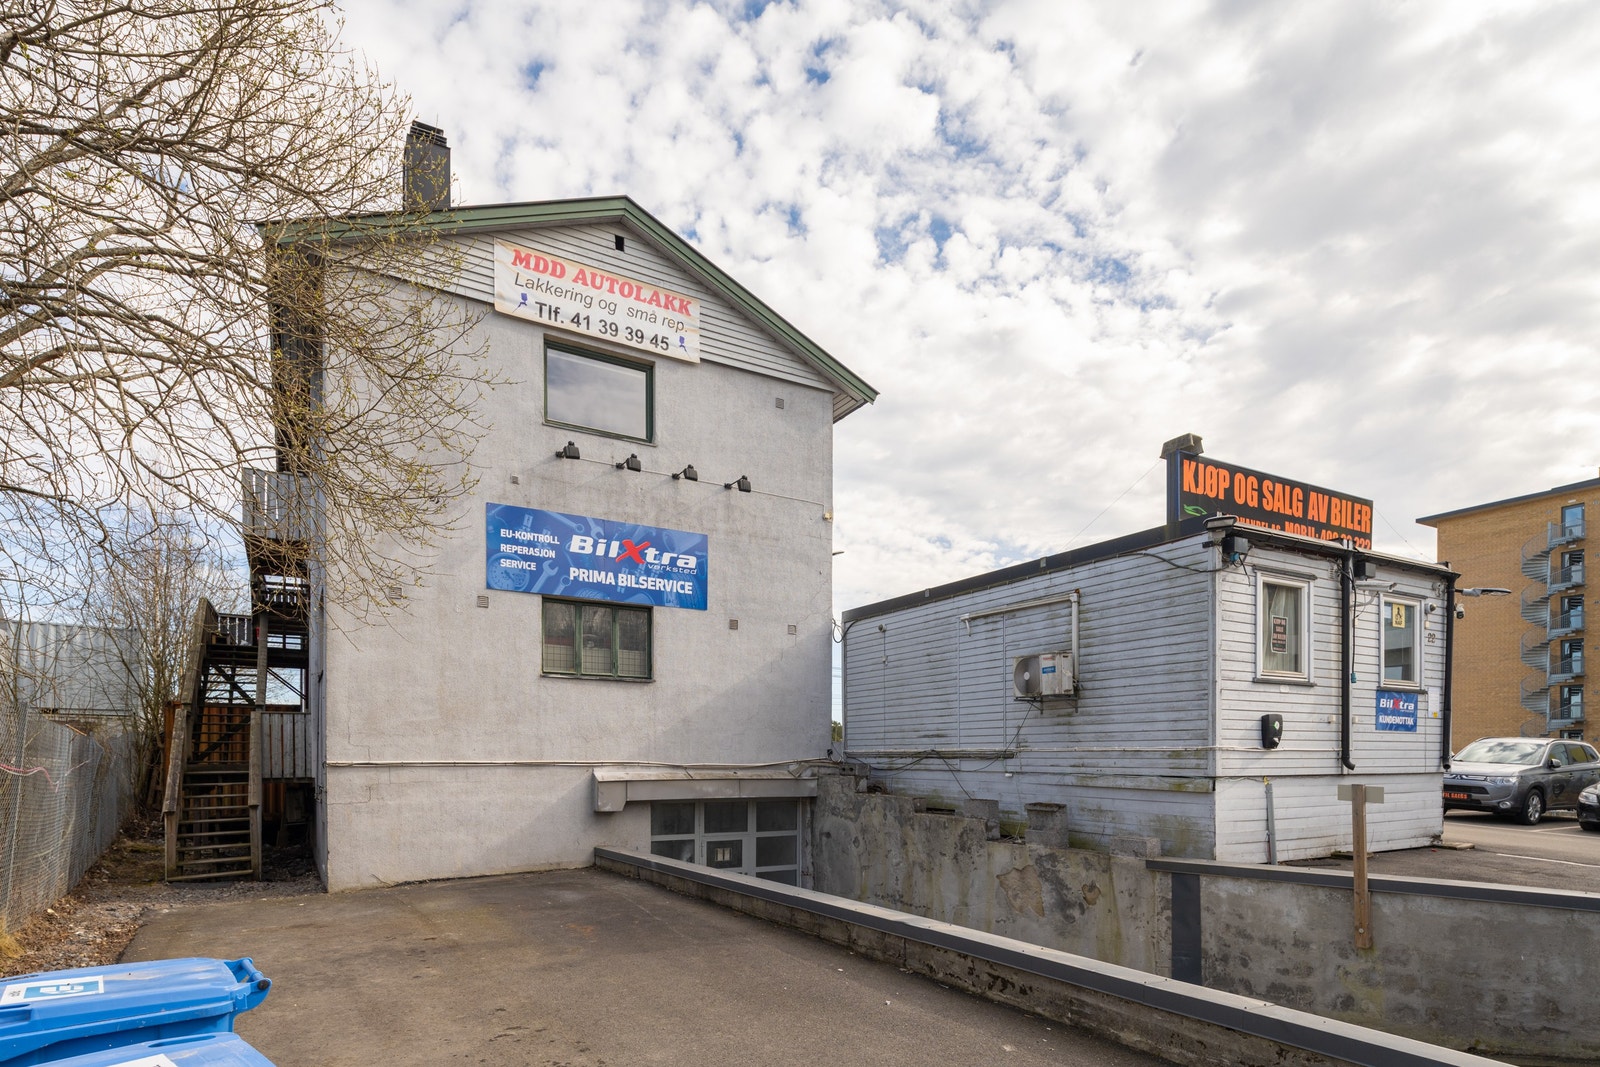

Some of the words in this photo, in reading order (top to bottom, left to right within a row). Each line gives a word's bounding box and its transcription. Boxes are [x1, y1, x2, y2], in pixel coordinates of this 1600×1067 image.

[511, 248, 566, 279] MDD
[572, 268, 692, 317] AUTOLAKK
[515, 272, 593, 309] Lakkering
[599, 299, 617, 315] og
[626, 306, 657, 324] små
[662, 318, 688, 333] rep.
[535, 301, 564, 324] Tlf.
[571, 312, 590, 330] 41
[598, 319, 618, 337] 39
[625, 326, 644, 344] 39
[650, 334, 669, 351] 45
[1183, 459, 1230, 500] KJØP
[1234, 472, 1258, 508] OG
[1262, 480, 1303, 518] SALG
[1308, 491, 1329, 524] AV
[1331, 497, 1372, 534] BILER
[500, 528, 560, 544] EU-KONTROLL
[500, 544, 556, 558] REPERASJON
[500, 558, 536, 570] SERVICE
[570, 535, 697, 569] BilXtra
[570, 567, 615, 586] PRIMA
[618, 574, 693, 594] BILSERVICE
[648, 564, 697, 574] verksted
[1379, 715, 1414, 725] KUNDEMOTTAK
